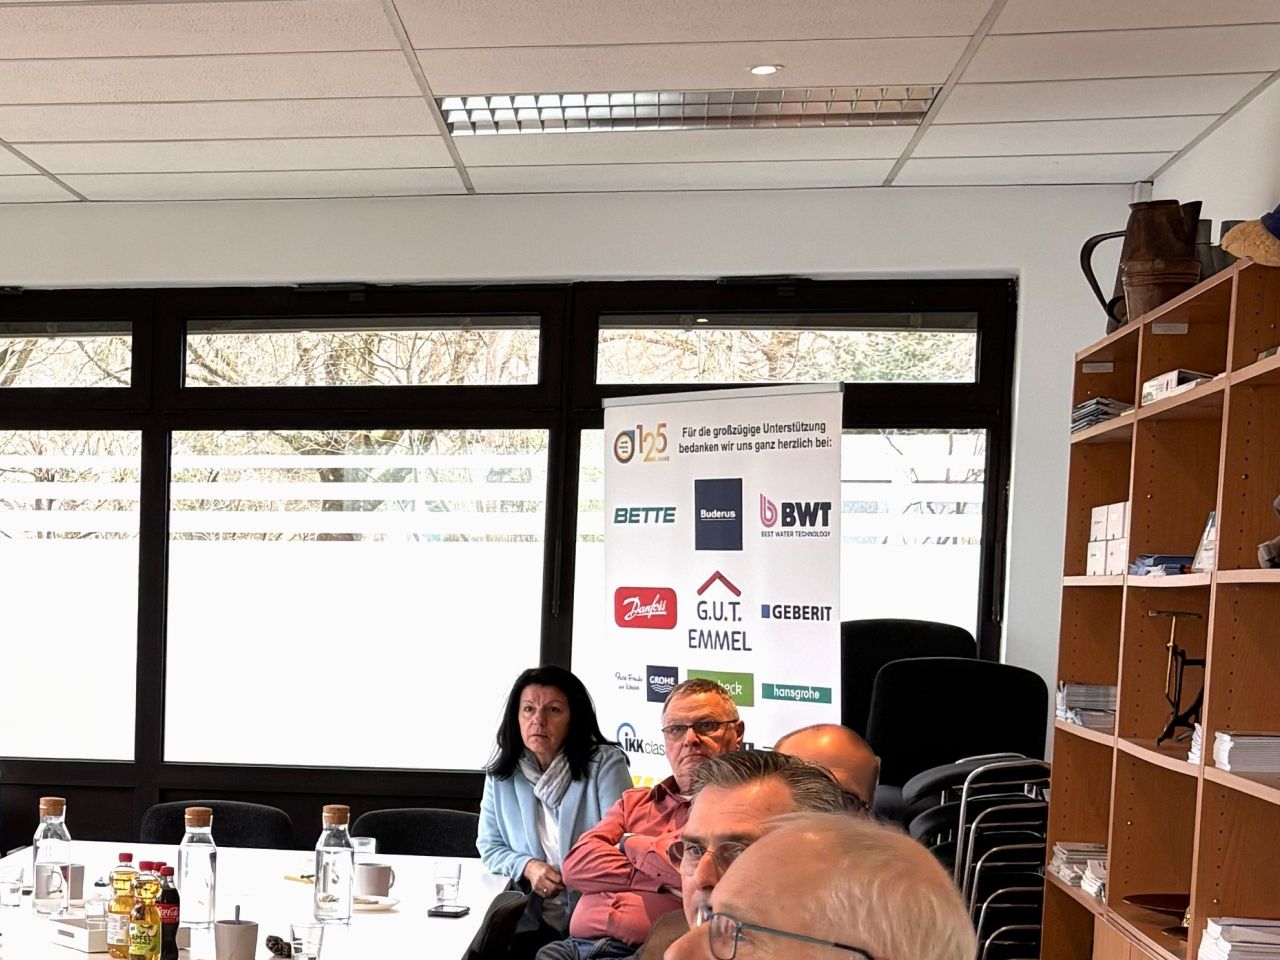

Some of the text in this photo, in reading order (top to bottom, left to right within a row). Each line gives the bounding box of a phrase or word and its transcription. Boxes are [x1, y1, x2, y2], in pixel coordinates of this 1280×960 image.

[682, 422, 826, 438] Für die großzügige Unterstützung
[679, 437, 832, 453] bedanken wir uns ganz herzlich bei:
[614, 507, 676, 524] BETTE
[700, 509, 736, 518] Buderus
[781, 502, 831, 527] BWT
[697, 601, 742, 622] G.U.T.
[773, 605, 832, 621] GEBERIT
[689, 629, 752, 651] EMMEL
[650, 676, 675, 685] GROHE
[774, 684, 820, 700] hansgrohe
